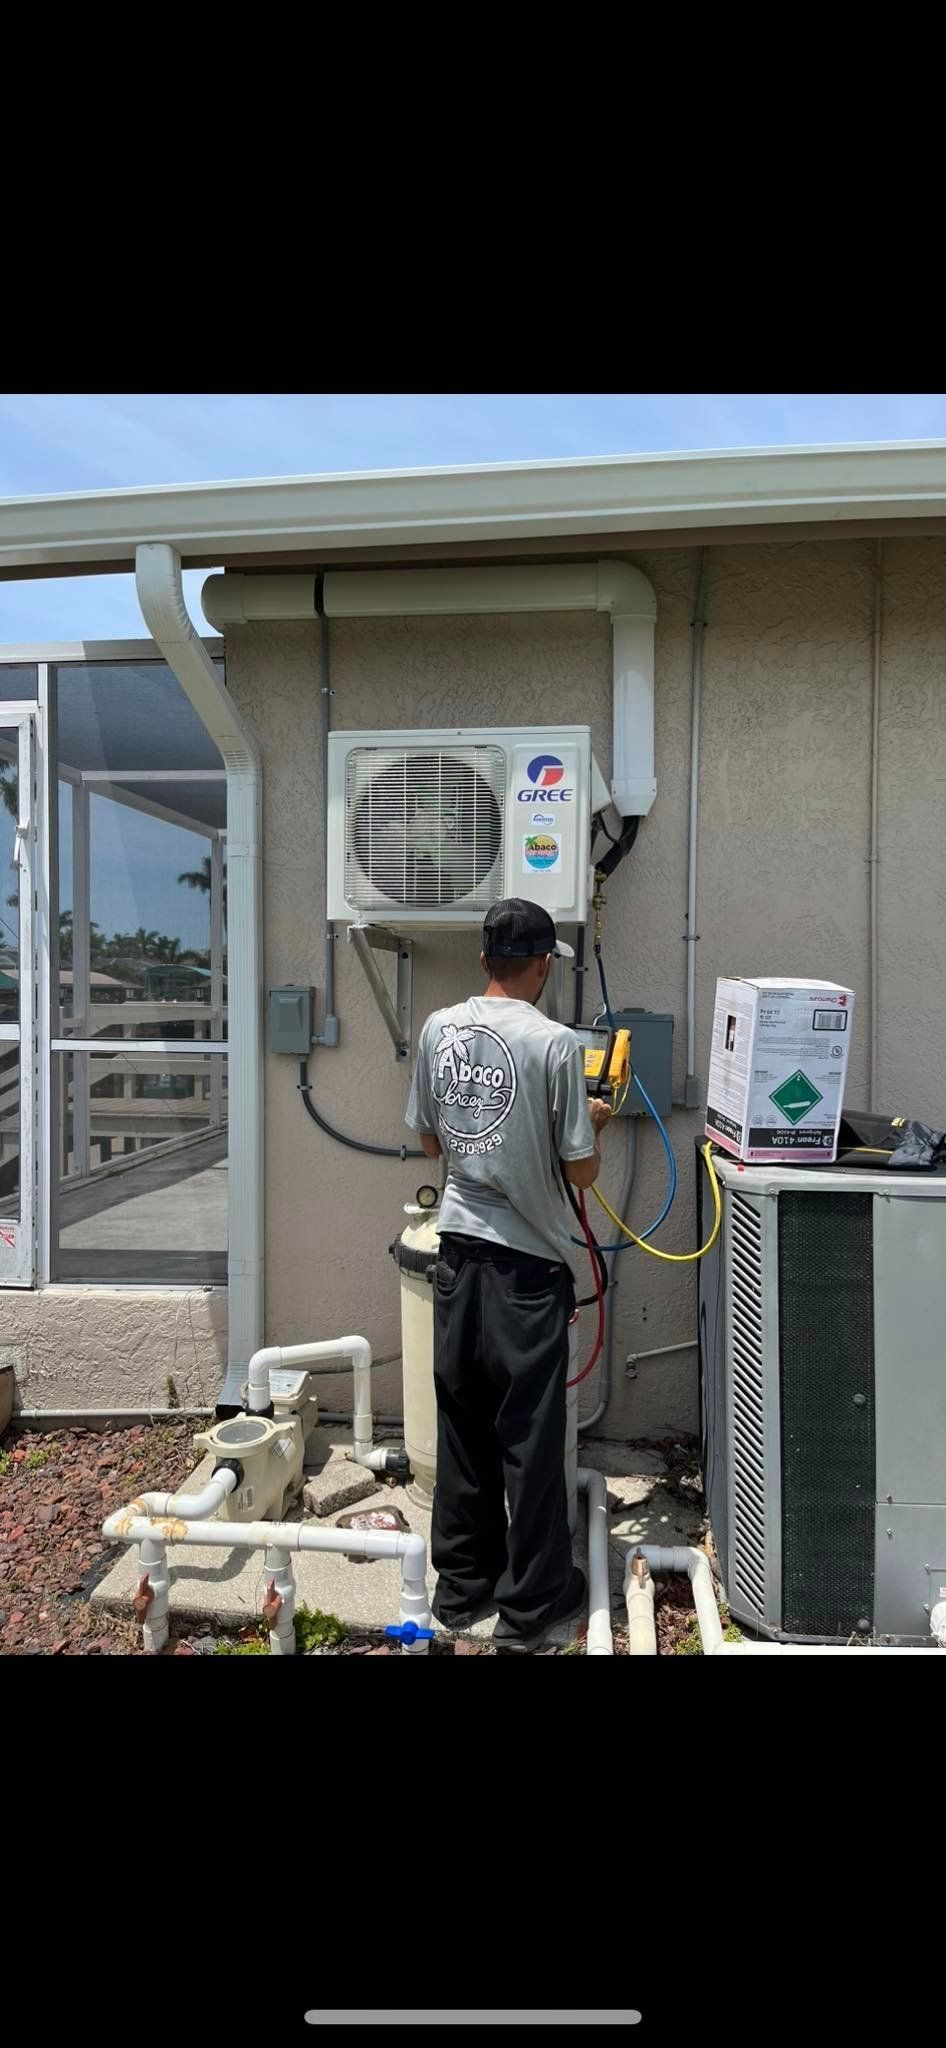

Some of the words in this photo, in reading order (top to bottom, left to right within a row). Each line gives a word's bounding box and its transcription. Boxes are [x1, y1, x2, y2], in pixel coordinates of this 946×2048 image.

[517, 789, 574, 802] GREE
[438, 1048, 504, 1087] Abaco
[771, 1136, 795, 1145] 410A
[797, 1136, 821, 1145] Freon
